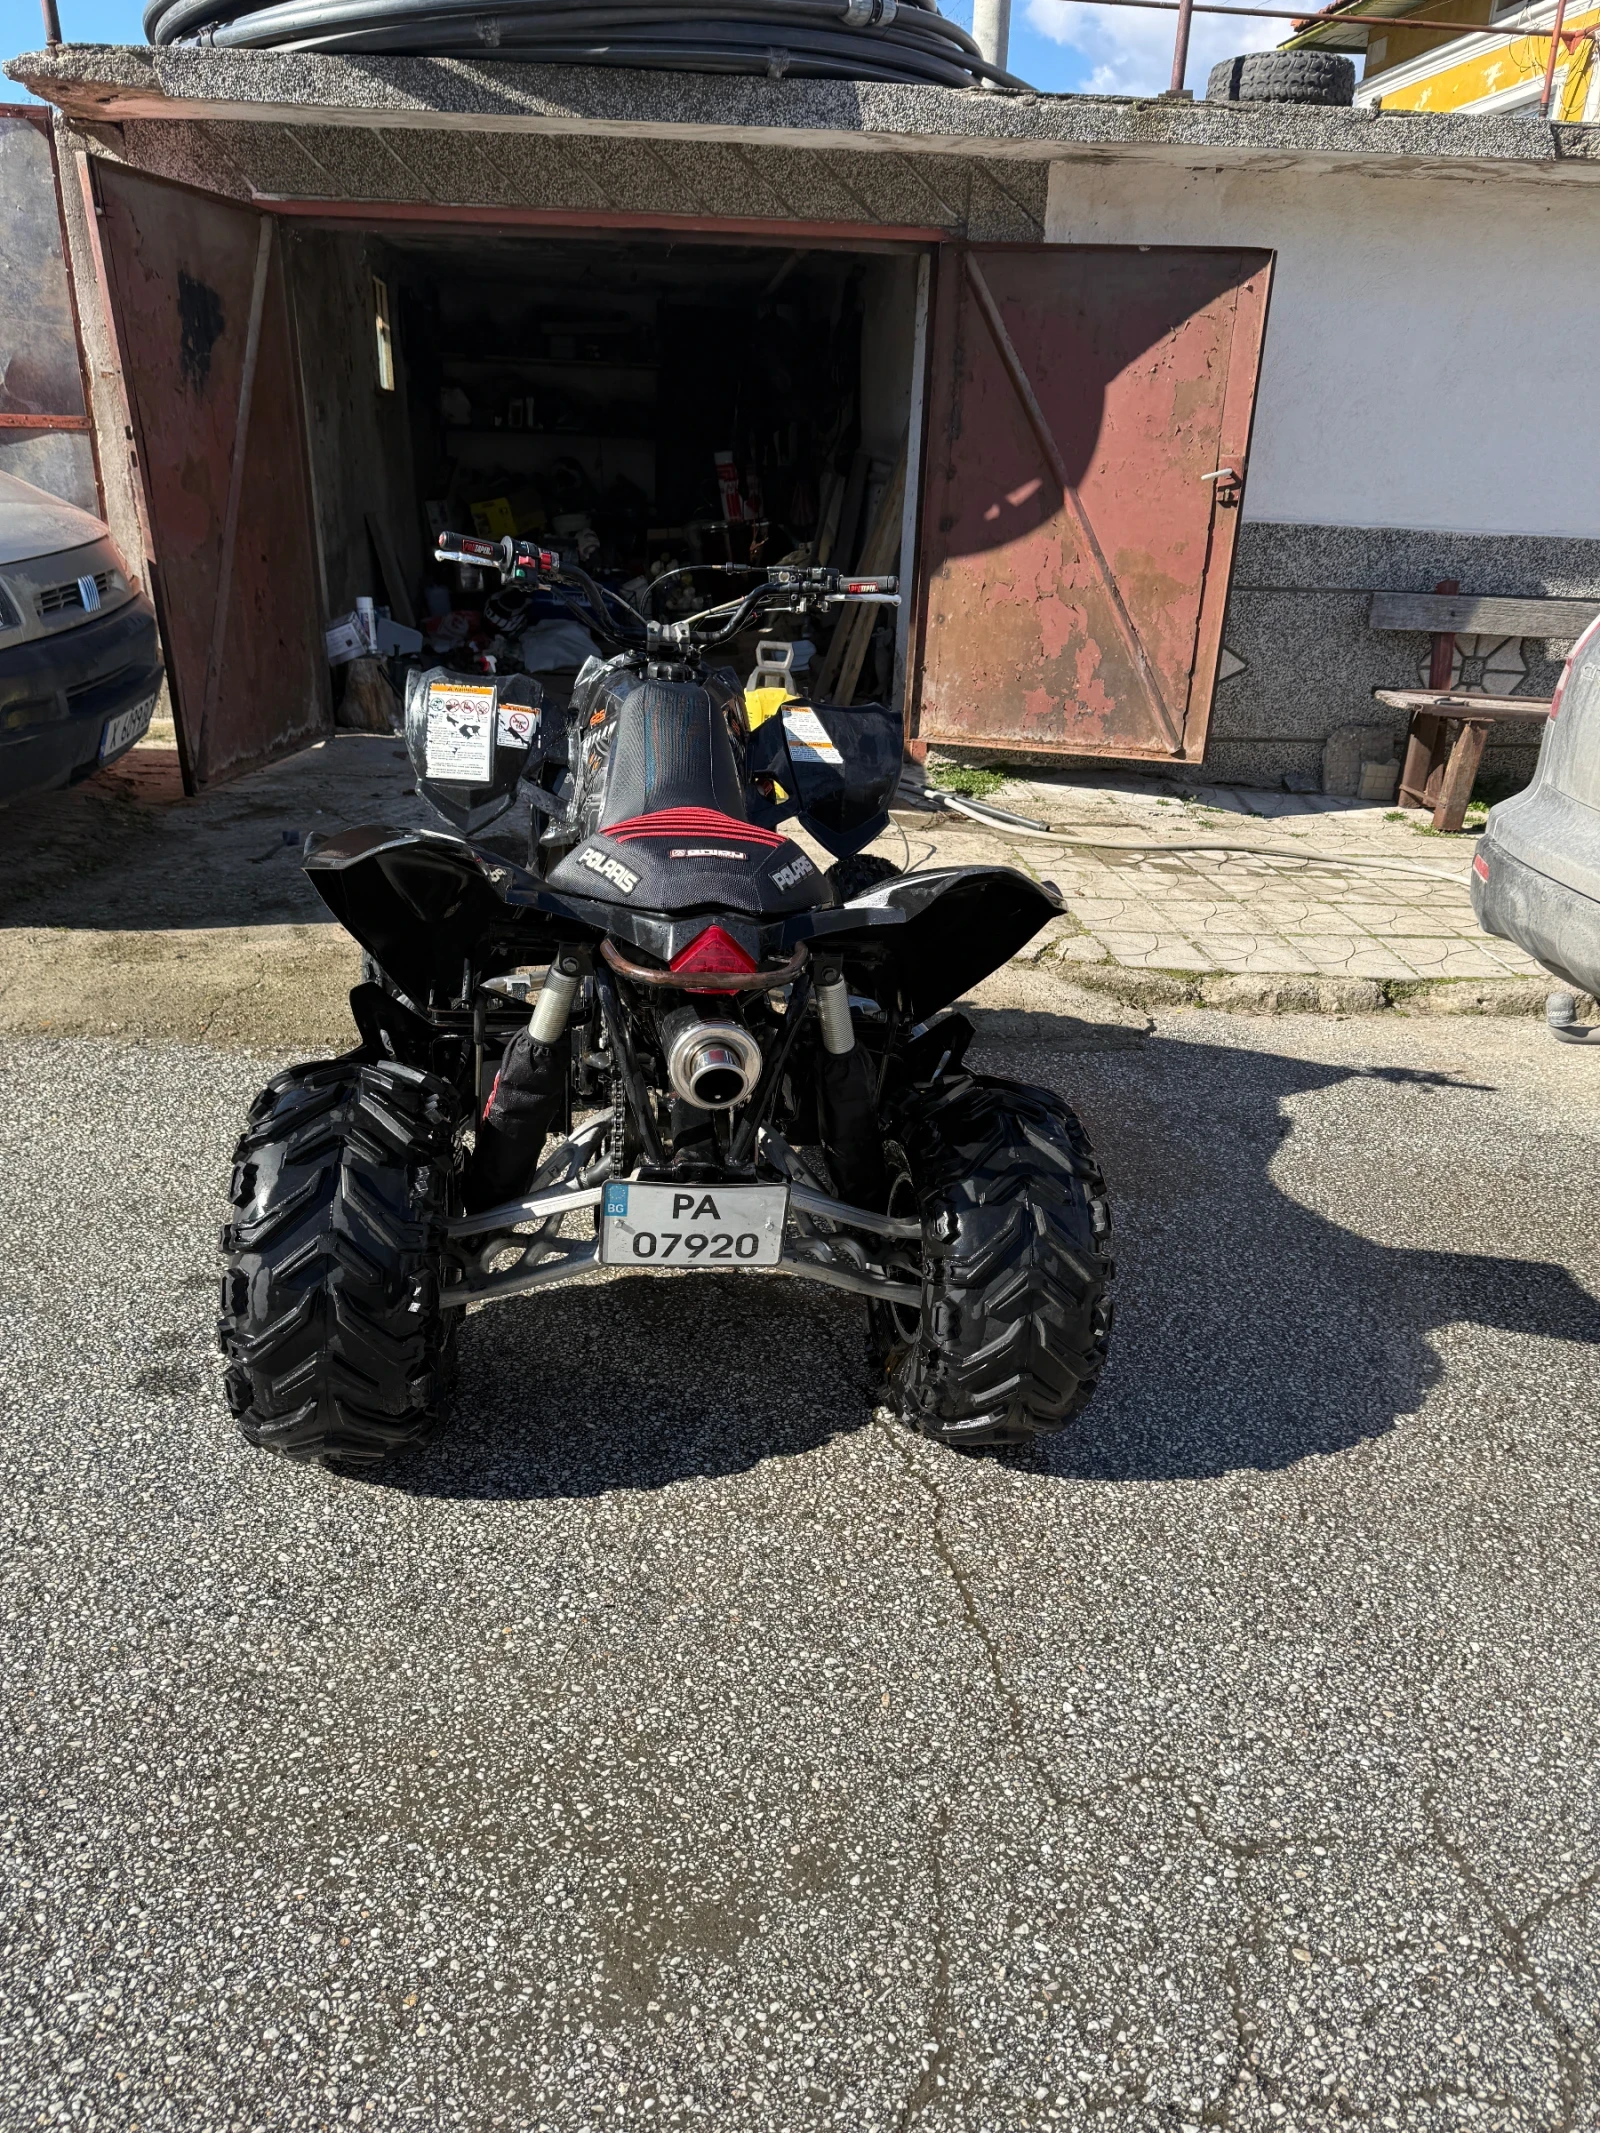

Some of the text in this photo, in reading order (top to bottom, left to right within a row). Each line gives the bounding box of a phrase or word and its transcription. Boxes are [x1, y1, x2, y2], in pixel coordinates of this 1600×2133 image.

[578, 847, 639, 893] POLARIS
[607, 1203, 624, 1213] BG
[672, 1193, 721, 1220] PA
[632, 1231, 759, 1259] 07920
